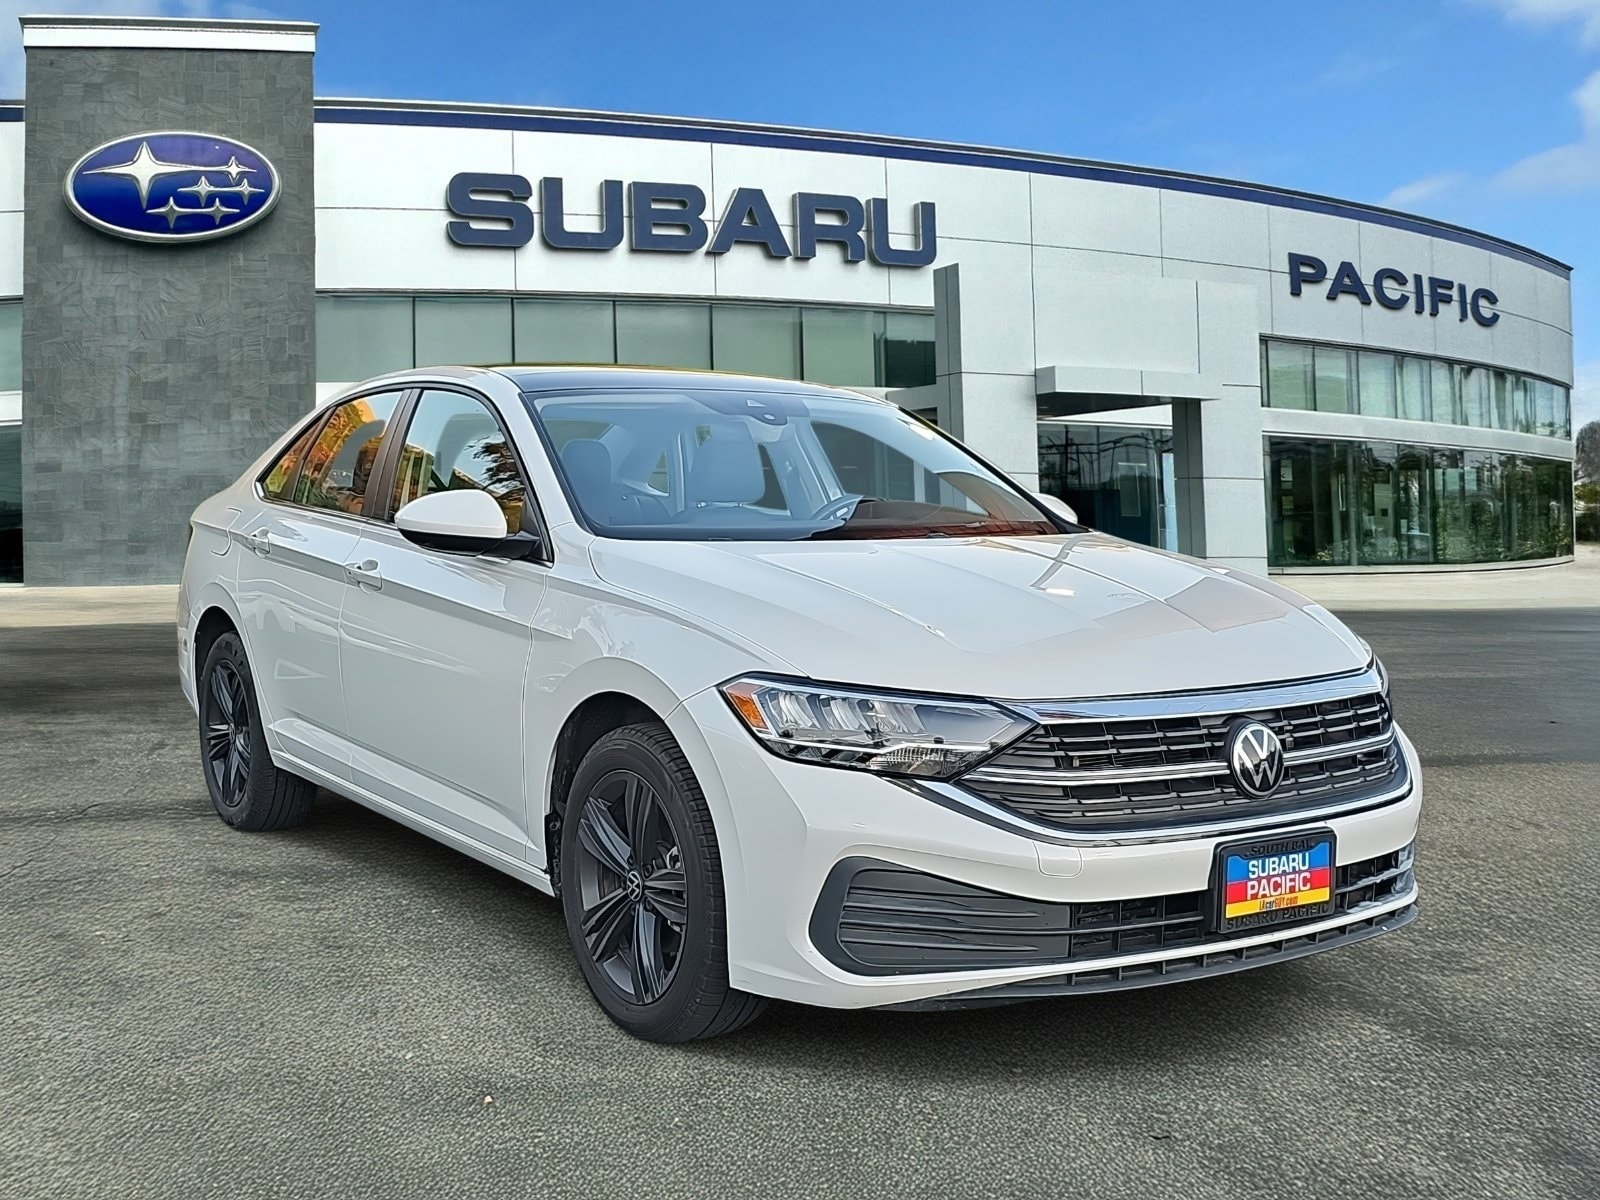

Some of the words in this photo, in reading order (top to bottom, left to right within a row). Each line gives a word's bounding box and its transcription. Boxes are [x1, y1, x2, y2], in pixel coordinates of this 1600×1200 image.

[447, 171, 938, 268] SUBARU
[1288, 252, 1500, 327] PACIFIC
[1247, 872, 1311, 900] PACIFIC
[1248, 852, 1309, 879] SUBARU
